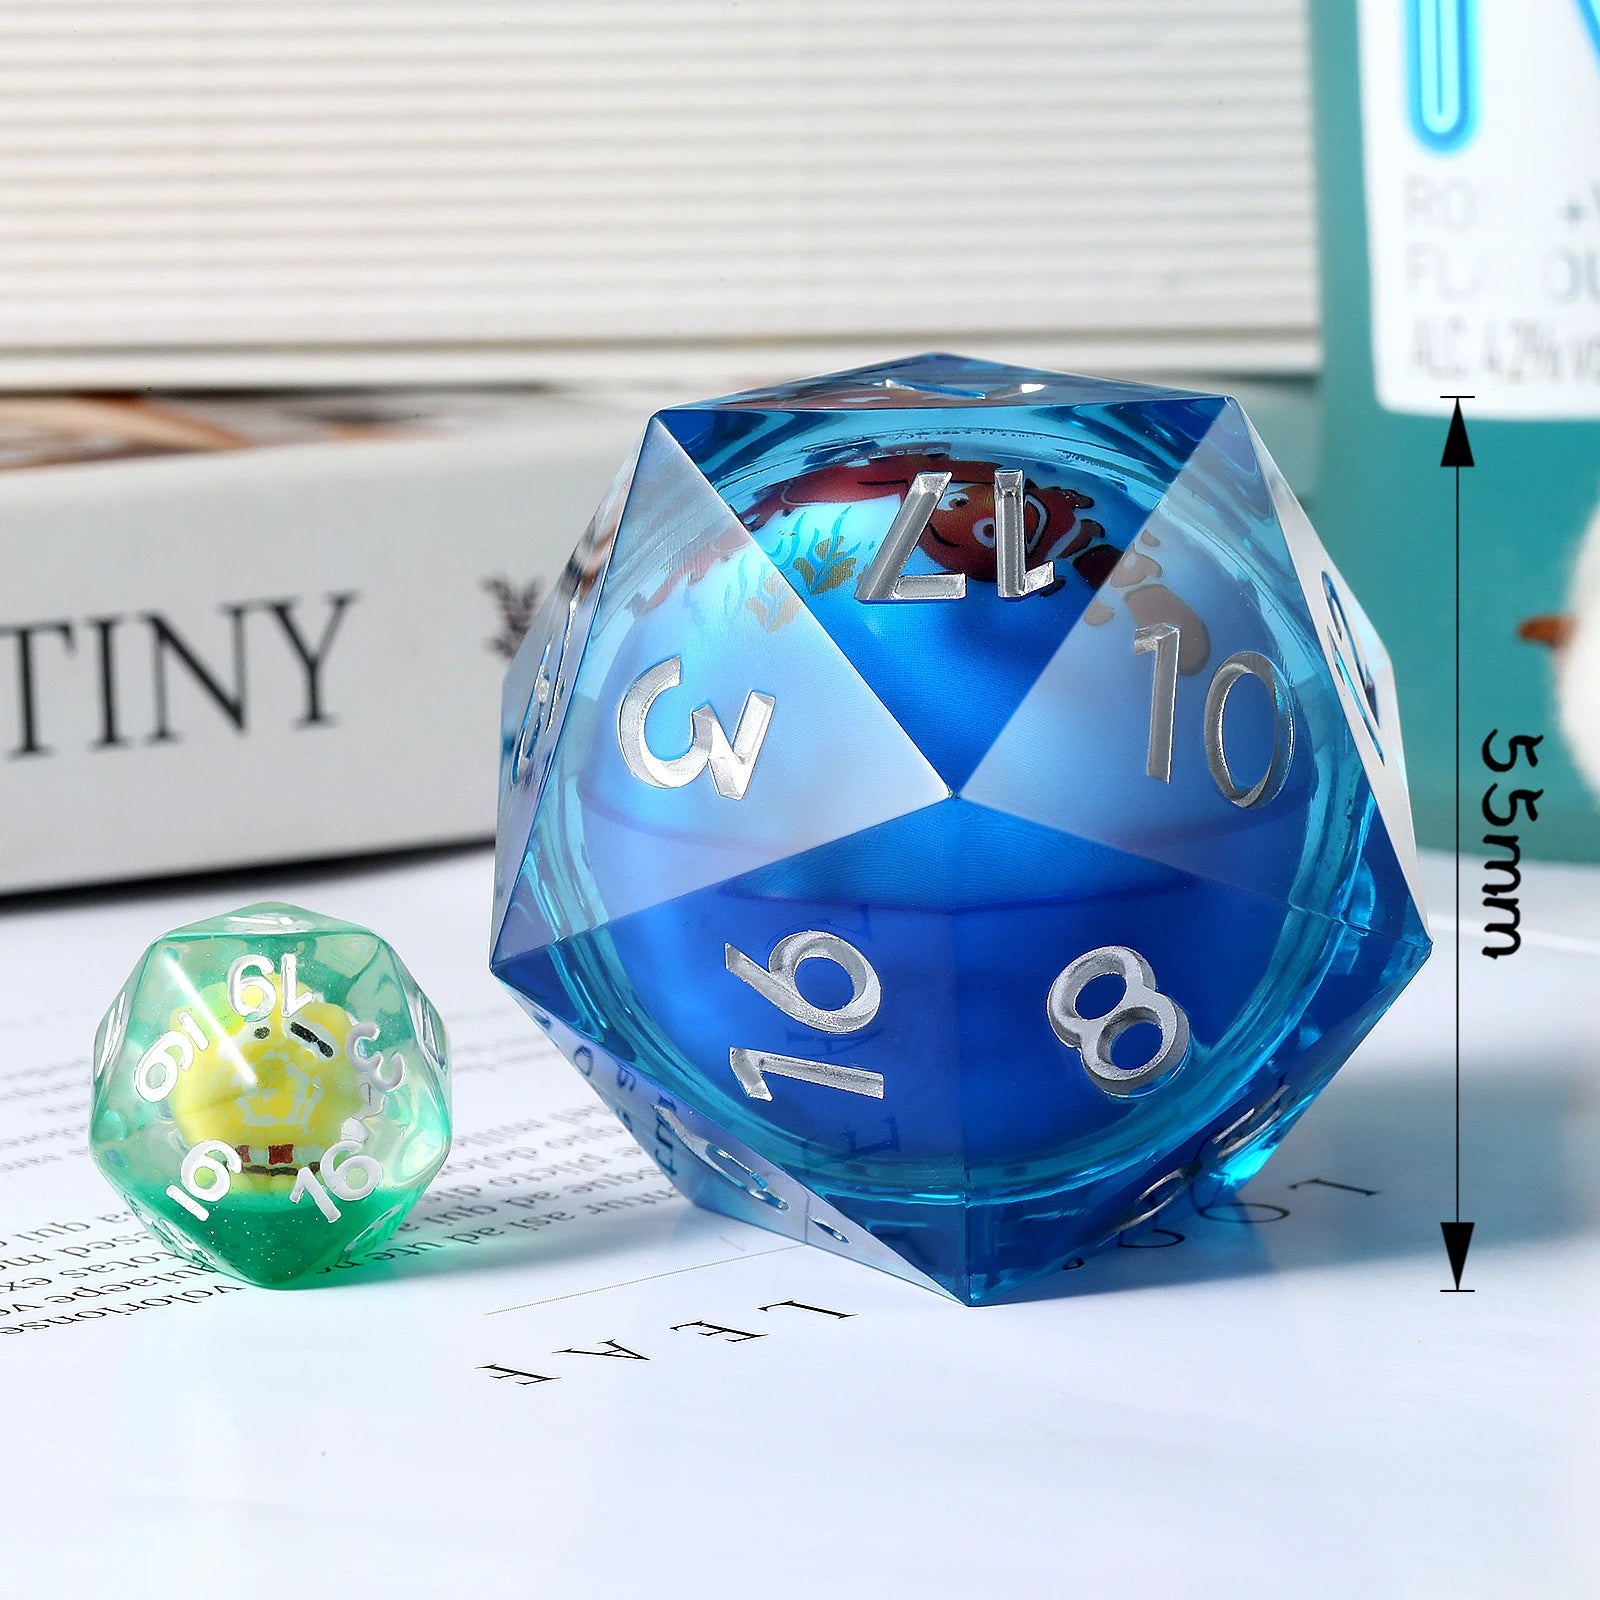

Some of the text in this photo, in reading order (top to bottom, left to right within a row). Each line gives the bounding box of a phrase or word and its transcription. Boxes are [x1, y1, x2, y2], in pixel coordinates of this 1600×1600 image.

[858, 469, 1055, 604] 17
[0, 588, 361, 758] TINY
[1133, 622, 1296, 808] 10
[617, 654, 777, 802] 3
[228, 954, 314, 1020] 19
[725, 930, 885, 1102] 16
[1046, 945, 1193, 1099] 8
[14, 1221, 91, 1244] qui
[290, 1140, 382, 1224] 16
[423, 1203, 498, 1228] qui
[0, 1283, 247, 1335] volorionse
[58, 1250, 184, 1280] totas
